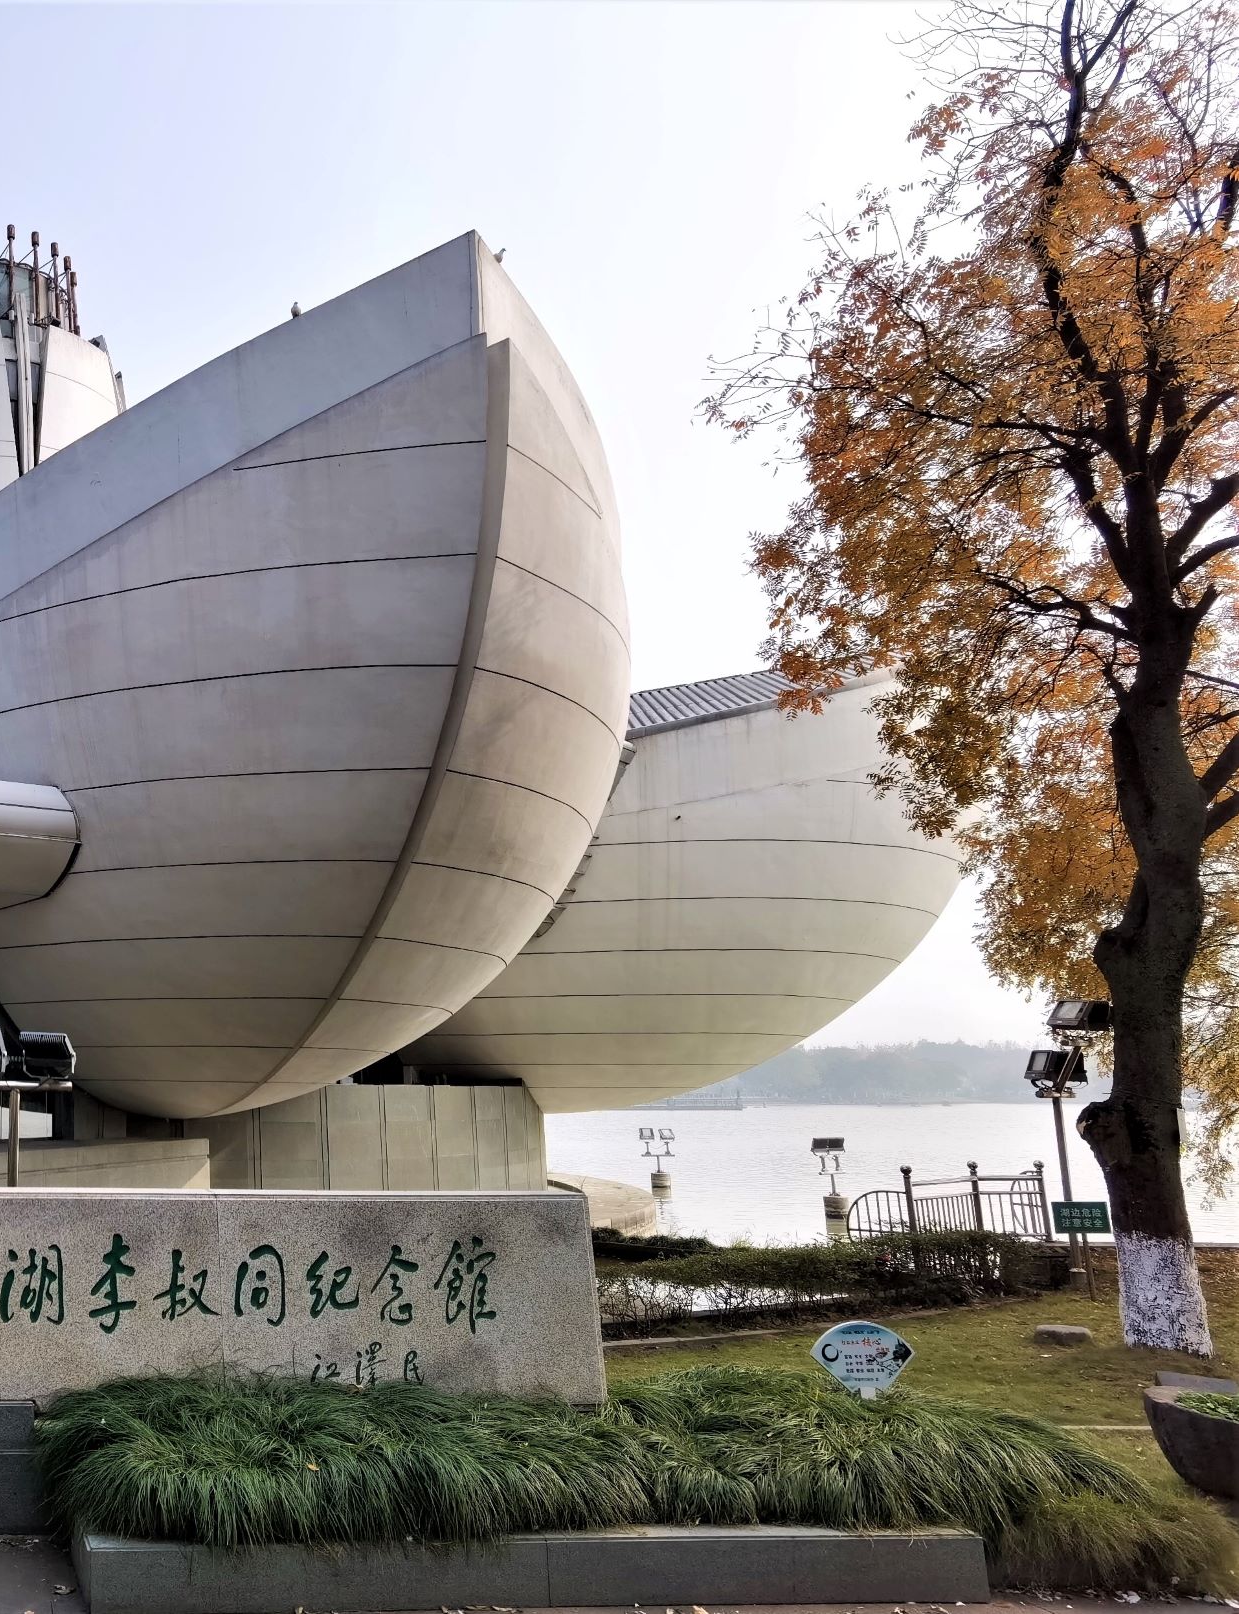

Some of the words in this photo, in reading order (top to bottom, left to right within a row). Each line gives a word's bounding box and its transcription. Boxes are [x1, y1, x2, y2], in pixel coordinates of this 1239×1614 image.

[1060, 1208, 1102, 1218] 湖边危险
[1061, 1218, 1104, 1228] 注意安全
